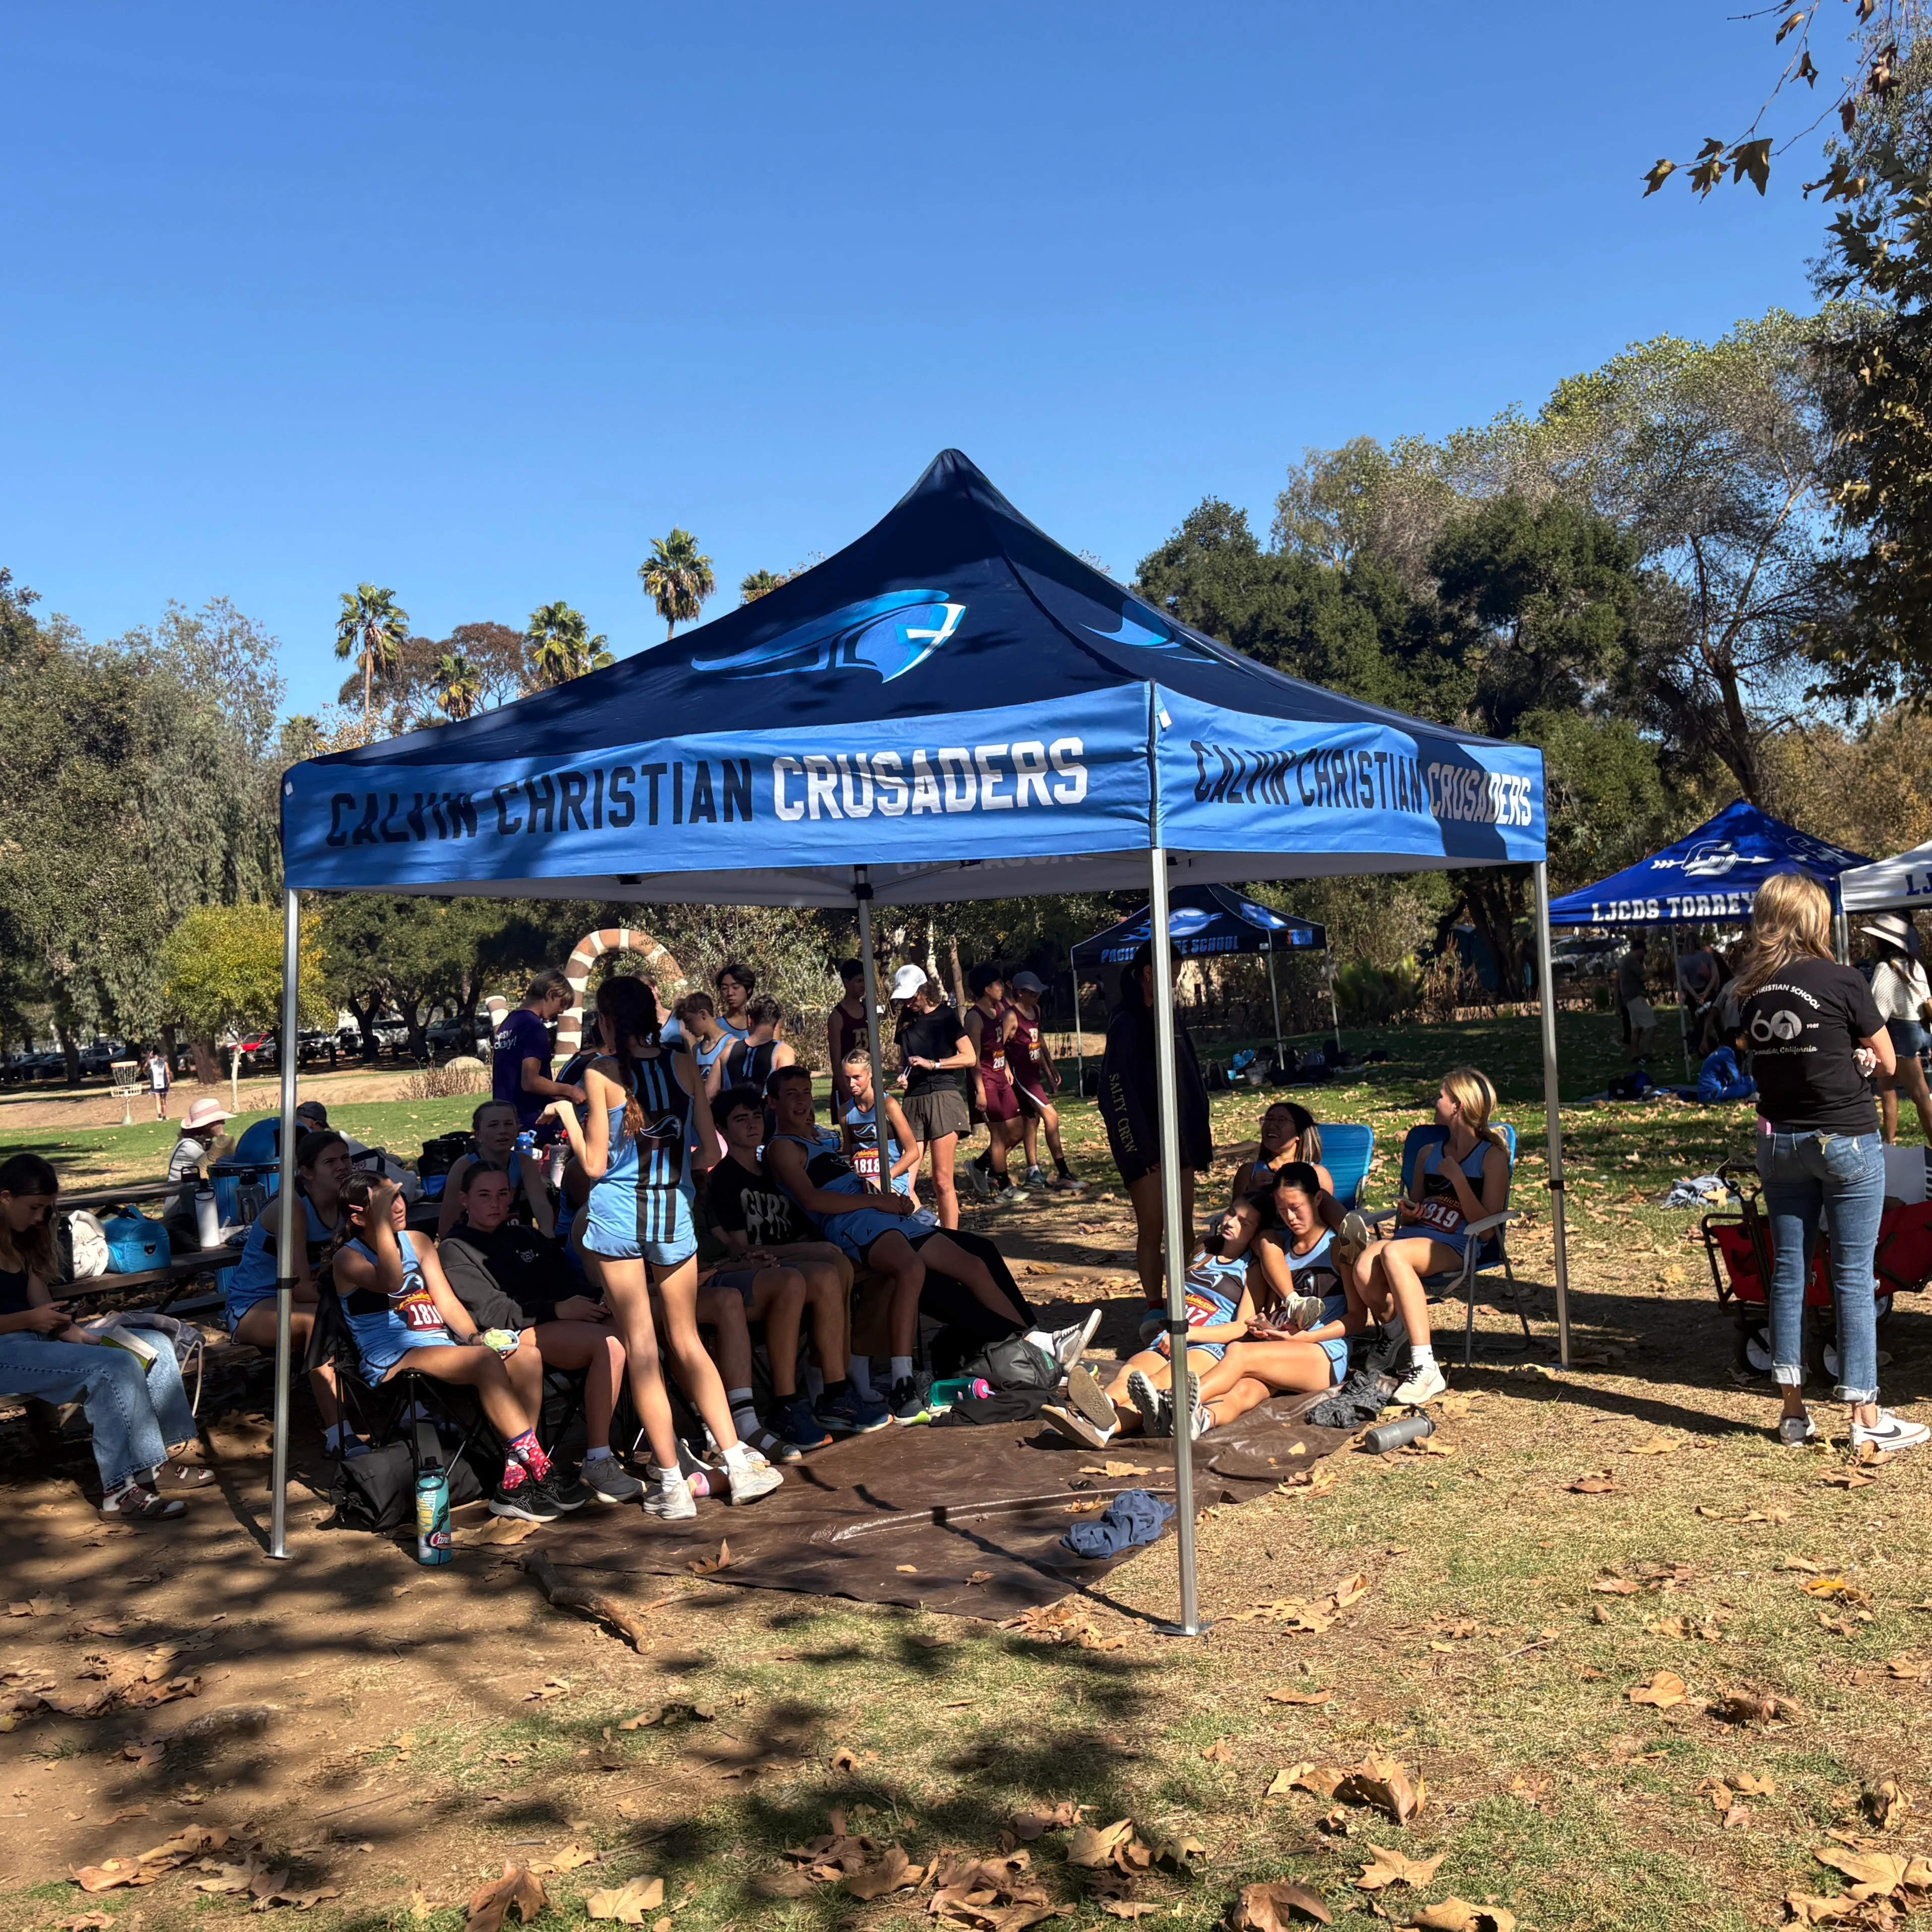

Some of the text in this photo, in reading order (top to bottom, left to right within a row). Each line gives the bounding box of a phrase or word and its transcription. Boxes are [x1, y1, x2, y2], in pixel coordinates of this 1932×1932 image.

[326, 736, 1088, 847] CALVIN CHRISTIAN CRUSADERS
[1190, 740, 1531, 826] CALVIN CHRISTIAN CRUSADERS
[1592, 898, 1660, 922] LJCDS
[1190, 936, 1238, 953] SCHOOL
[1790, 986, 1820, 1010] SCHOOL
[1109, 1073, 1138, 1153] SALTY CREW
[854, 1158, 880, 1173] 1818
[1423, 1203, 1459, 1228] 819
